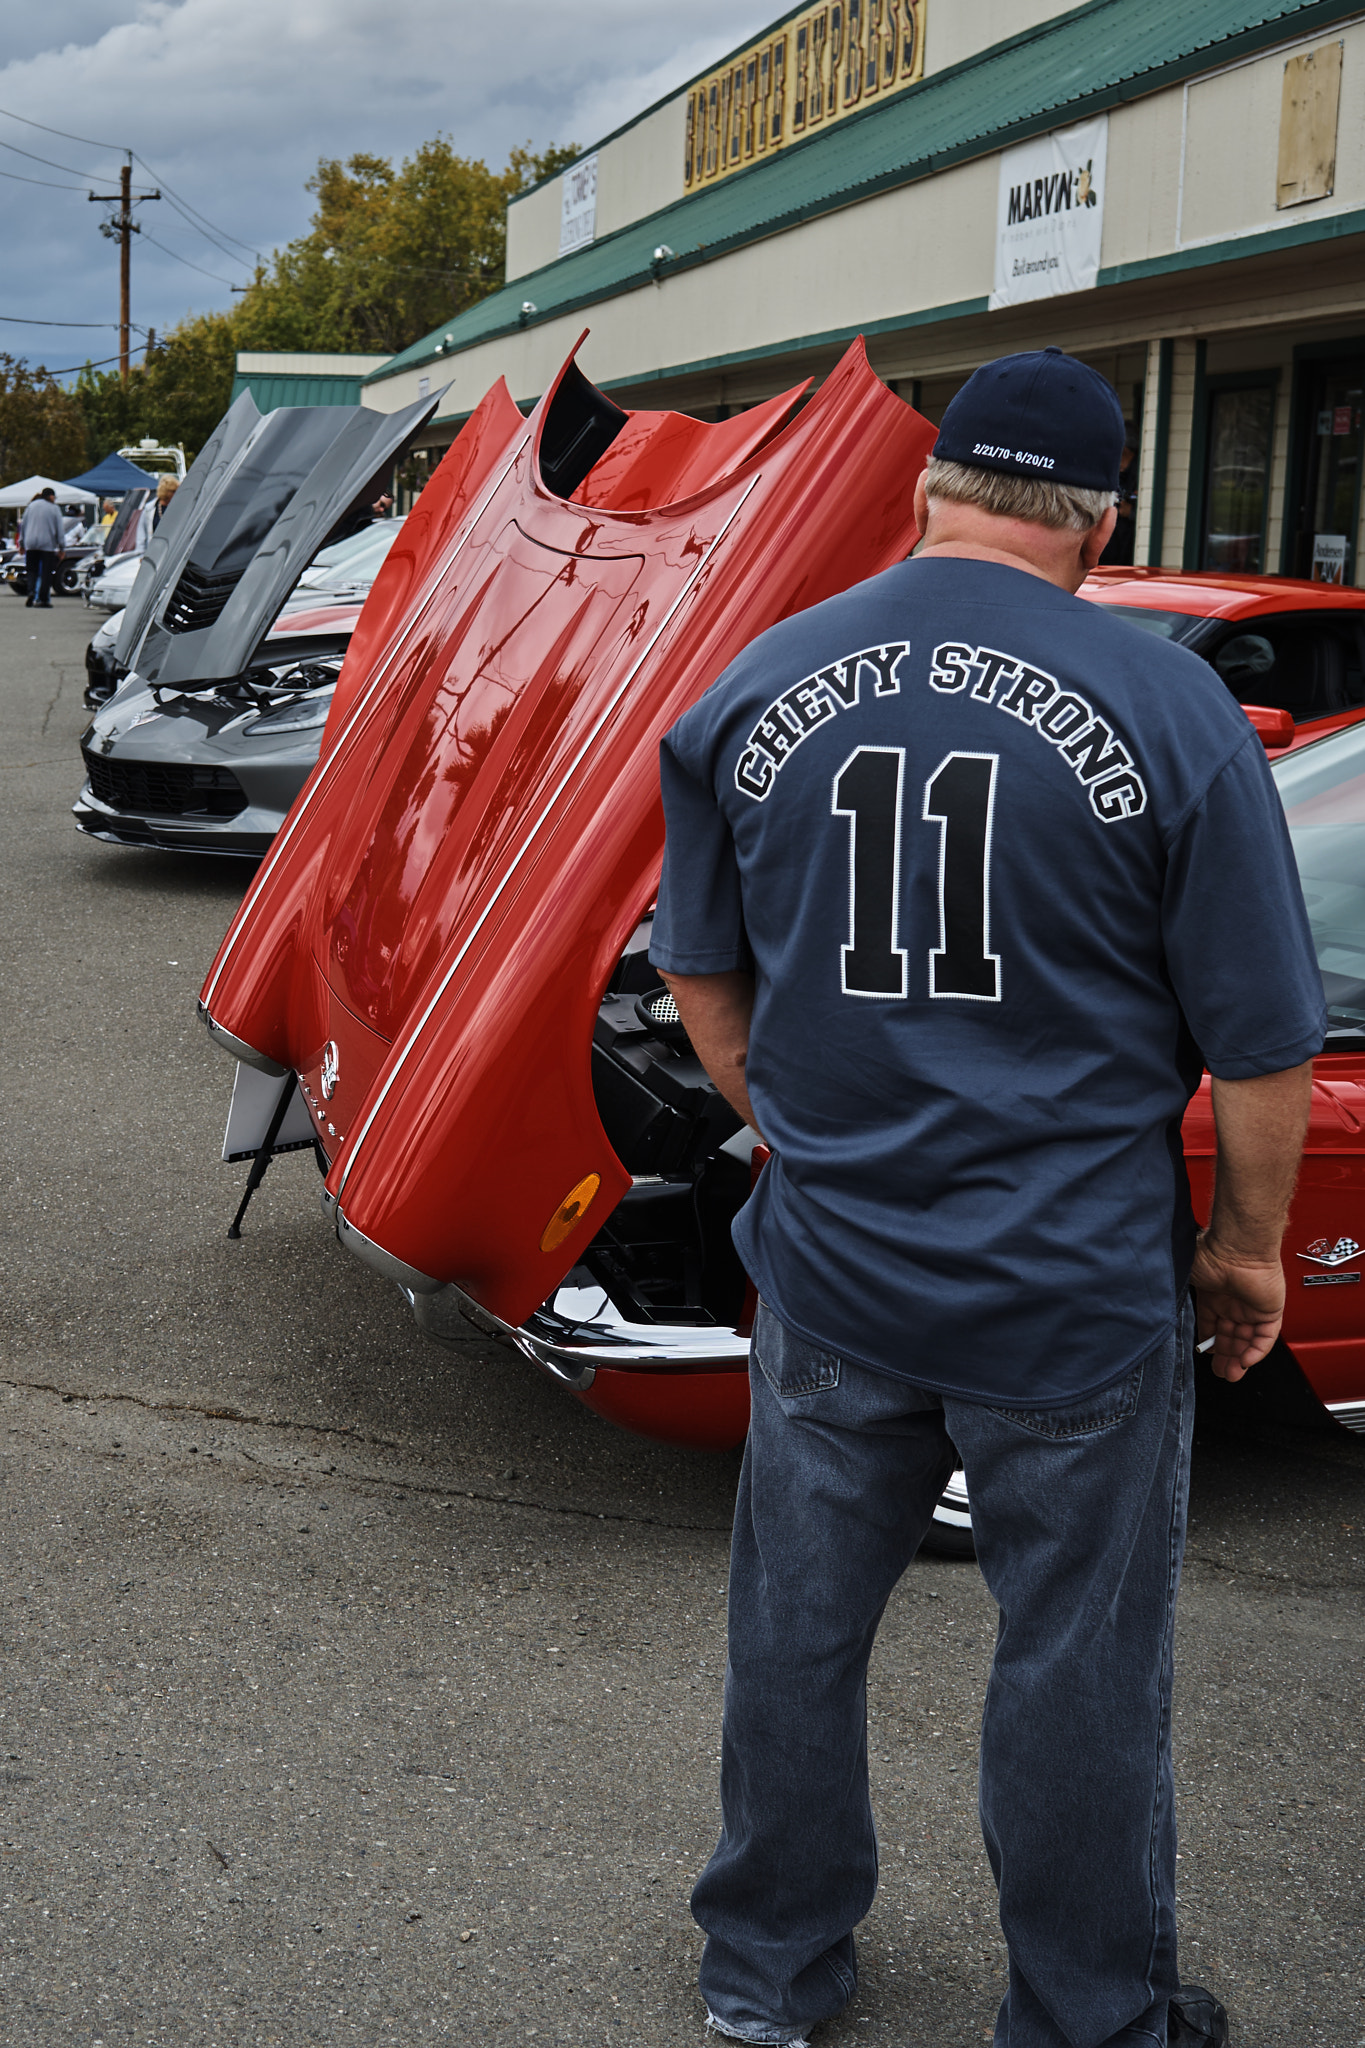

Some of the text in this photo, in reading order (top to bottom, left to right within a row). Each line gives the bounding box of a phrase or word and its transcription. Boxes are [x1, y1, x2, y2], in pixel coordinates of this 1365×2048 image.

[684, 0, 918, 187] CORVETTE EXPRESS
[1007, 169, 1073, 227] MARVIN
[972, 443, 1055, 470] 2/21/70-6/20/12
[735, 641, 1148, 824] CHEVY STRONG
[831, 745, 1002, 1002] 11
